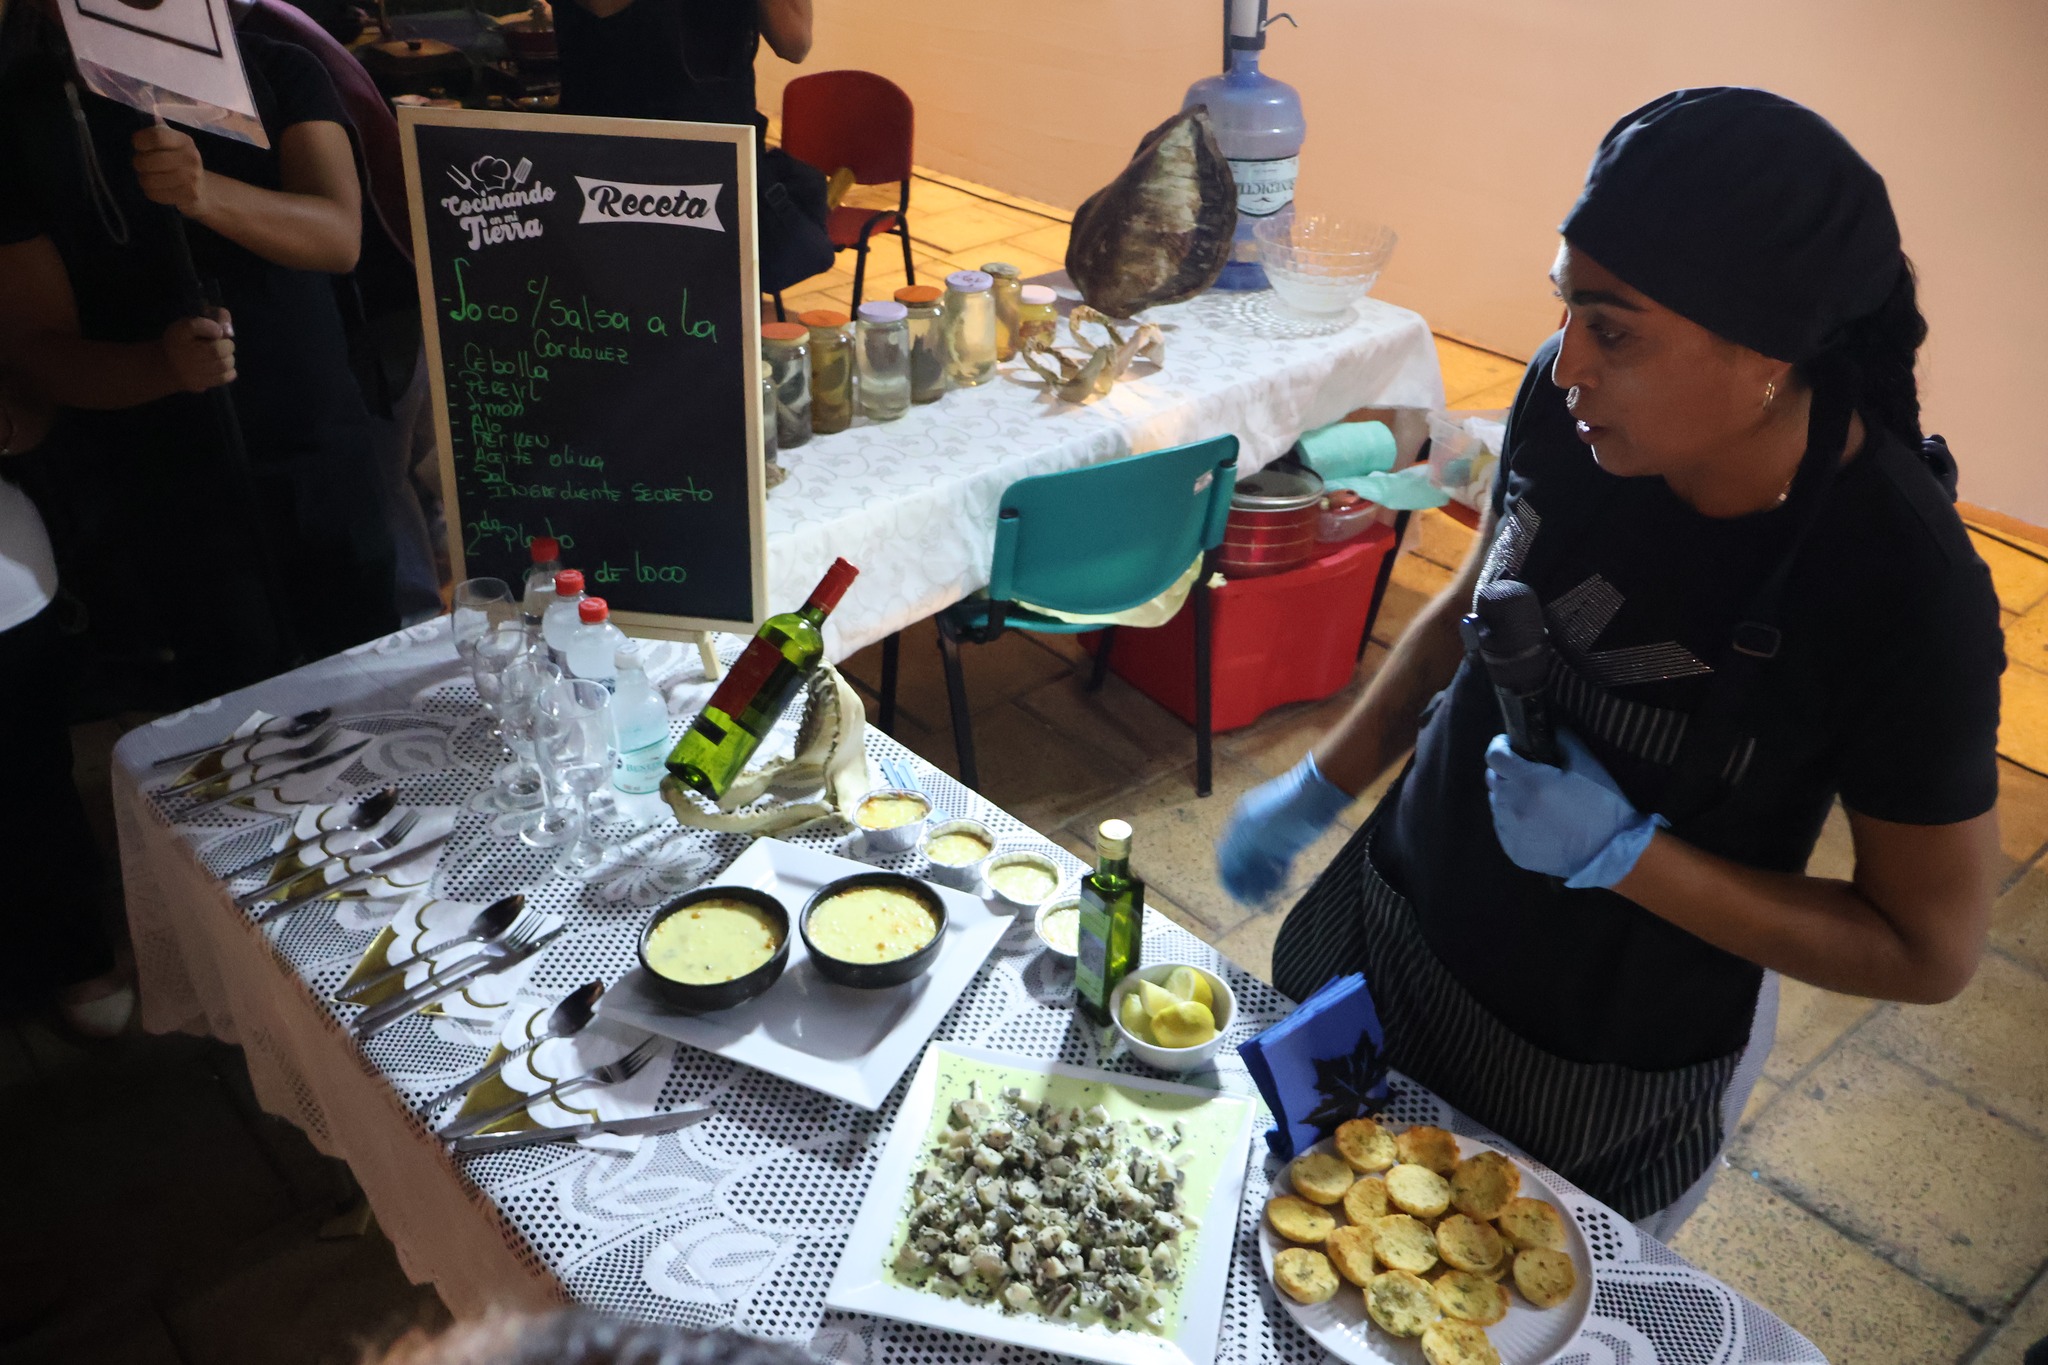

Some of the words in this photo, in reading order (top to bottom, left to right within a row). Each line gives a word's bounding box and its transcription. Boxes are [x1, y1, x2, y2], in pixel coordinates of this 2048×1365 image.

[441, 180, 557, 216] Cocinando
[588, 186, 711, 220] Receta
[460, 214, 544, 251] Tierra
[489, 216, 503, 226] en
[504, 210, 519, 223] mi
